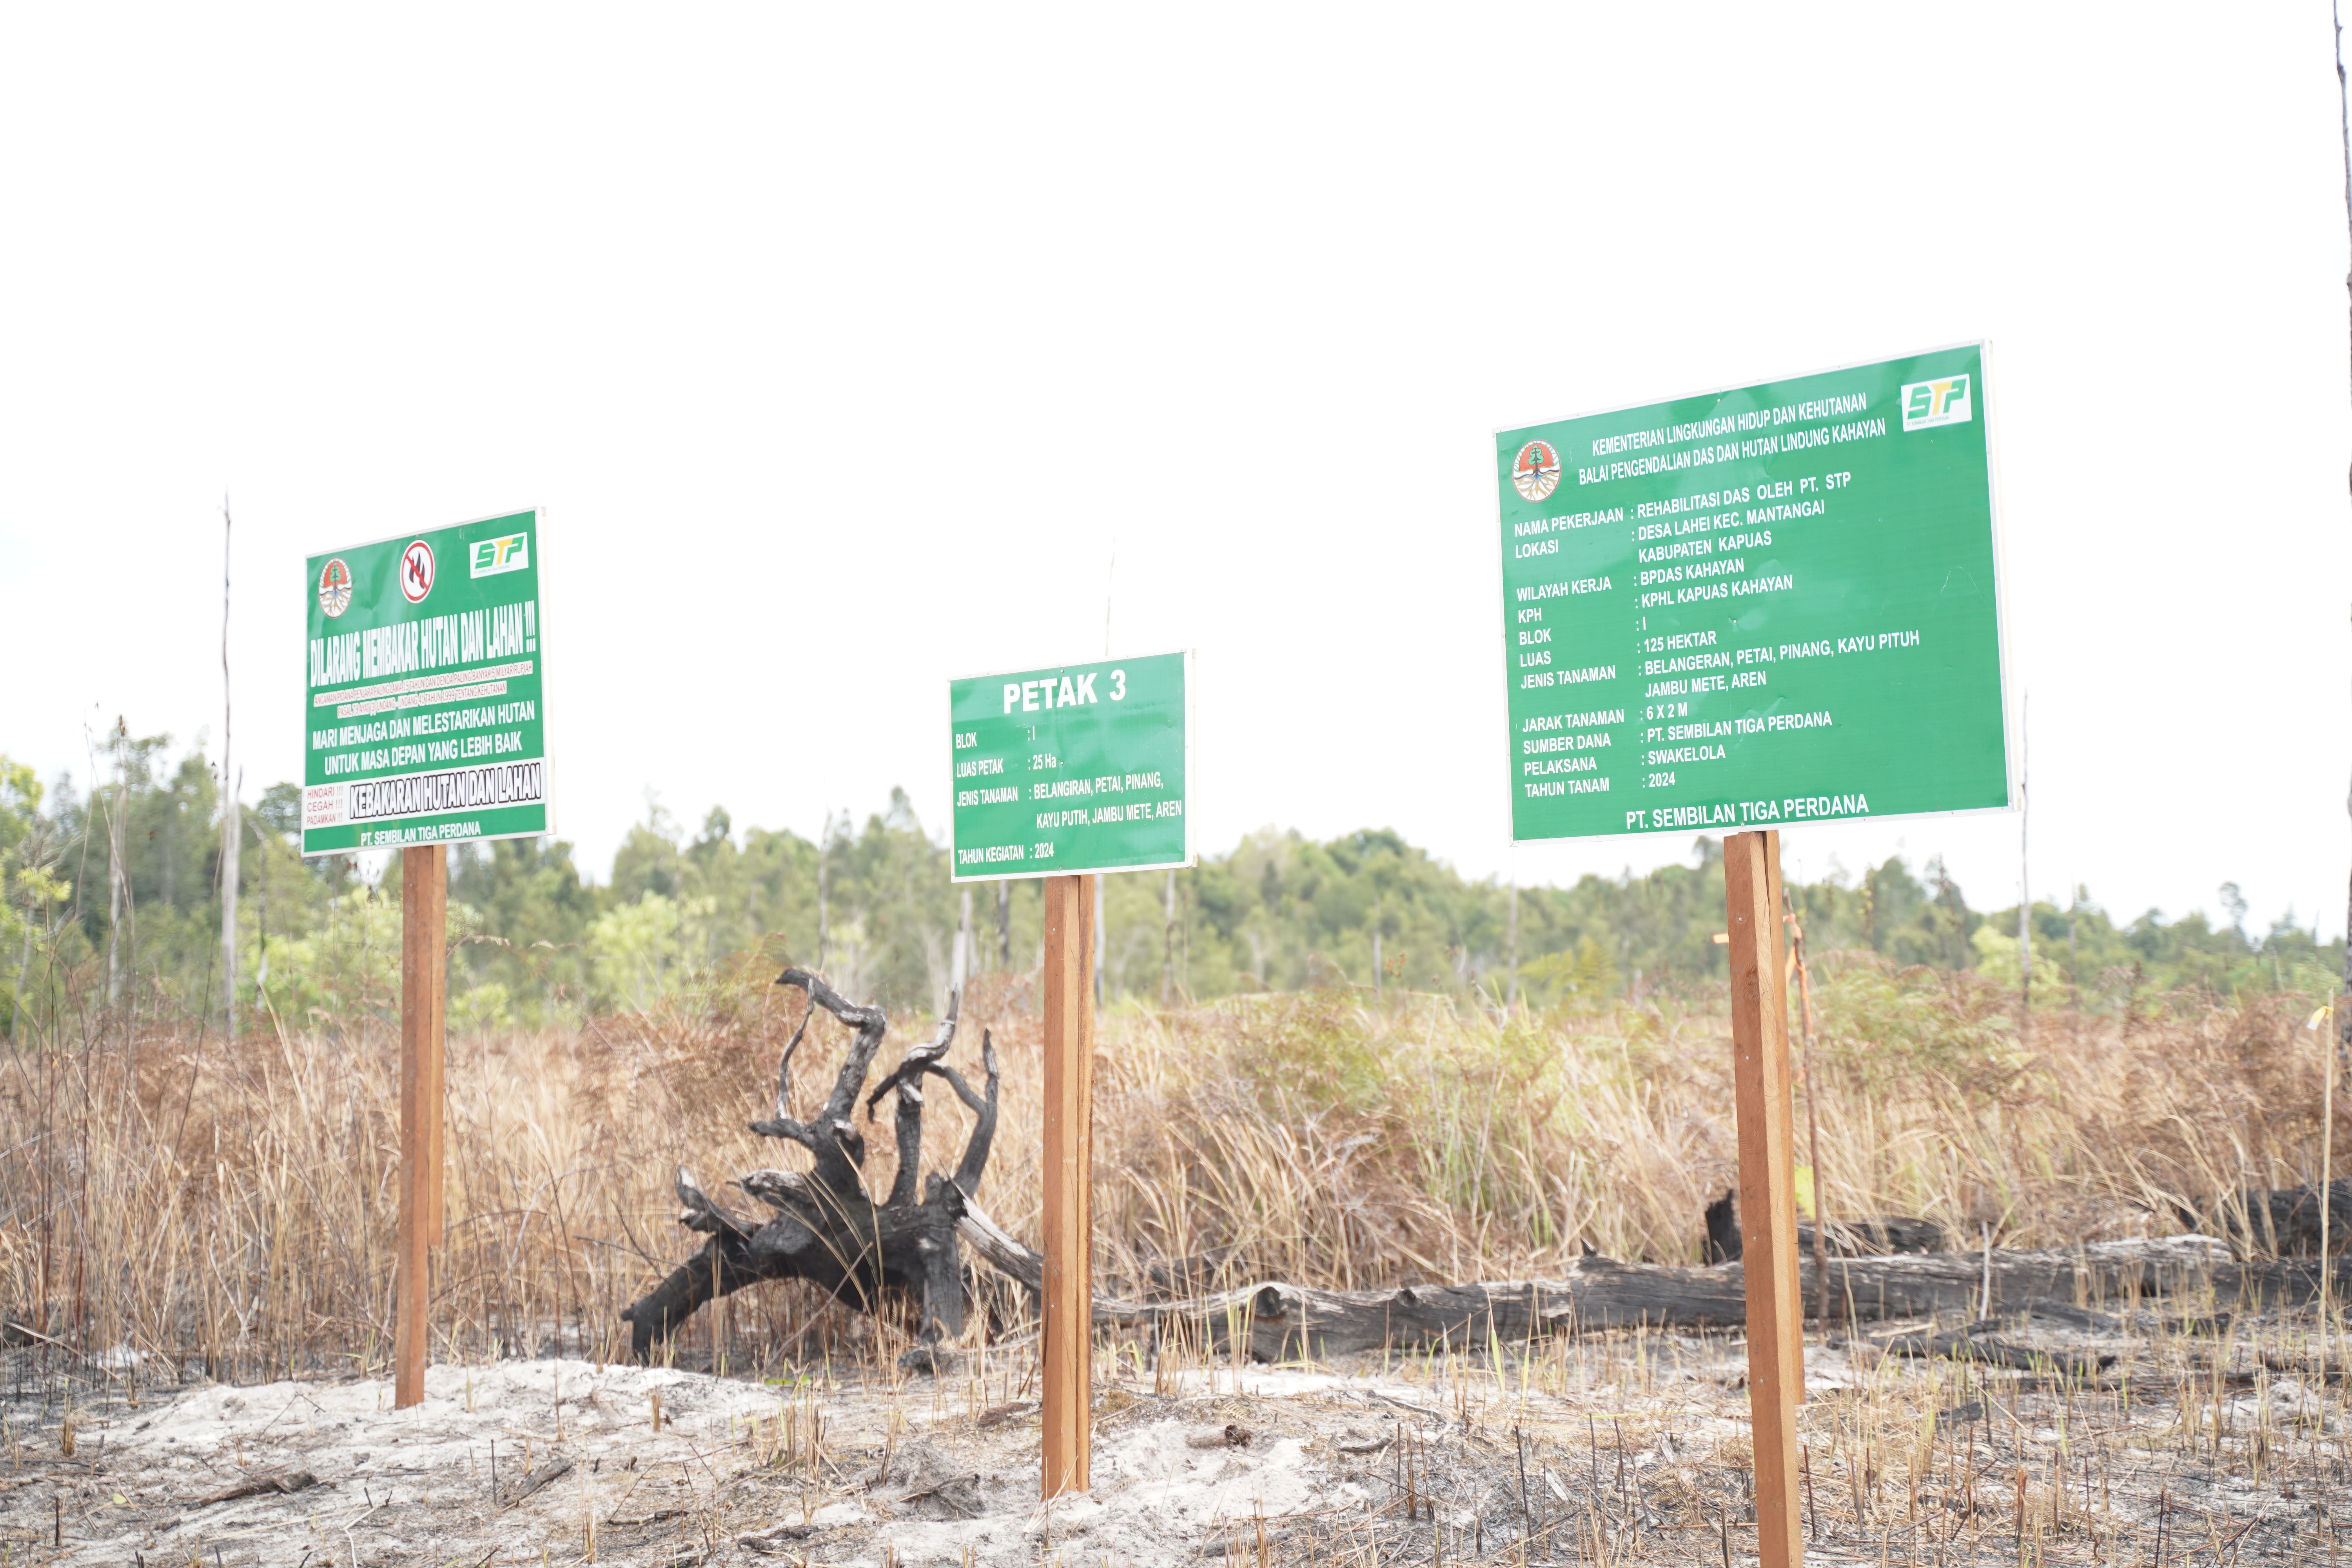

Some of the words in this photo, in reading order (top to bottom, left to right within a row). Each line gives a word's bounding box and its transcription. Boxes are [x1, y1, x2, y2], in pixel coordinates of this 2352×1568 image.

[1907, 378, 1967, 420] STP
[1592, 428, 1664, 456] KEMENTERIAN
[1667, 416, 1735, 443] LINGKUNGAN
[1738, 410, 1770, 431] HIDUP
[1773, 405, 1796, 425] DAN
[1798, 392, 1866, 421] KEHUTANAN
[1579, 465, 1609, 485] BALAI
[1611, 451, 1691, 479] PENGENDALIAN
[1693, 447, 1714, 466] DAS
[1717, 443, 1739, 462] DAN
[1742, 436, 1778, 458] HUTAN
[1781, 427, 1829, 451] LINDUNG
[1832, 418, 1886, 443] KAHAYAN
[1515, 519, 1549, 537] NAMA
[1552, 507, 1623, 531] PEKERJAAN
[1637, 492, 1720, 518] REHABILITASI
[1724, 487, 1750, 505] DAS
[1757, 481, 1793, 499] OLEH
[1800, 477, 1818, 493] PT.
[1826, 472, 1851, 489] STP
[1515, 539, 1558, 559] LOKASI
[1639, 523, 1672, 541] DESA
[1675, 516, 1710, 535] LAHEI
[1714, 512, 1743, 529] KEC.
[1747, 499, 1824, 524] MANTANGAI
[1639, 539, 1712, 563] KABUPATEN
[1719, 530, 1772, 551] KAPUAS
[475, 535, 524, 570] STP
[1517, 582, 1568, 601] WILAYAH
[1572, 576, 1612, 594] KERJA
[1641, 566, 1682, 585] BPDAS
[1686, 558, 1744, 579] KAHAYAN
[1518, 608, 1542, 623] KPH
[1642, 591, 1675, 608] KPHL
[1678, 583, 1728, 603] KAPUAS
[1732, 574, 1793, 596] KAHAYAN
[310, 632, 360, 687] DILARANG
[363, 621, 419, 679] MEMBAKAR
[421, 614, 458, 669] HUTAN
[461, 610, 483, 663] DAN
[486, 603, 523, 659] LAHAN
[1519, 628, 1552, 645] BLOK
[1520, 651, 1551, 667] LUAS
[1644, 637, 1664, 652] 125
[1667, 631, 1717, 650] HEKTAR
[1521, 672, 1554, 689] JENIS
[1557, 665, 1616, 684] TANAMAN
[1645, 652, 1733, 675] BELANGERAN,
[1737, 647, 1776, 664] PETAI,
[1780, 640, 1834, 659] PINANG,
[1838, 635, 1874, 653] KAYU
[1879, 630, 1919, 649] PITUH
[1004, 673, 1098, 714] PETAK
[1109, 669, 1126, 701] 3
[1645, 679, 1688, 697] JAMBU
[1691, 675, 1728, 693] METE,
[1731, 671, 1766, 688] AREN
[313, 729, 337, 749] MARI
[339, 722, 388, 746] MENJAGA
[390, 718, 410, 739] DAN
[413, 706, 495, 735] MELESTARIKAN
[498, 700, 534, 724] HUTAN
[1523, 715, 1563, 732] JARAK
[1565, 709, 1624, 728] TANAMAN
[1647, 706, 1653, 720] 6
[1657, 704, 1664, 719] X
[1668, 704, 1675, 718] 2
[1678, 702, 1688, 717] M
[1524, 736, 1574, 754] SUMBER
[1577, 733, 1611, 749] DANA
[1648, 727, 1664, 742] PT.
[1668, 720, 1731, 740] SEMBILAN
[1735, 717, 1765, 734] TIGA
[1768, 711, 1833, 731] PERDANA
[325, 753, 359, 775] UNTUK
[361, 749, 390, 770] MASA
[392, 744, 425, 766] DEPAN
[428, 739, 457, 761] YANG
[461, 735, 492, 758] LEBIH
[495, 731, 522, 753] BAIK
[956, 732, 977, 749] BLOK
[956, 761, 976, 778] LUAS
[978, 758, 1004, 775] PETAK
[1033, 754, 1043, 769] 25
[1045, 753, 1056, 768] Ha
[1524, 757, 1597, 776] PELAKSANA
[1648, 744, 1726, 765] SWAKELOLA
[307, 786, 334, 799] HINDARI
[350, 777, 421, 819] KEBAKARAN
[423, 771, 466, 811] HUTAN
[468, 768, 495, 806] DAN
[497, 762, 541, 803] LAHAN
[957, 790, 978, 807] JENIS
[980, 786, 1018, 804] TANAMAN
[1034, 779, 1093, 799] BELANGIRAN,
[1095, 776, 1123, 793] PETAI,
[1125, 771, 1163, 790] PINANG,
[1525, 781, 1564, 797] TAHUN
[1568, 777, 1609, 794] TANAM
[1649, 771, 1675, 787] 2024
[307, 800, 333, 812] CEGAH
[307, 813, 336, 825] PADAMKAN
[1036, 812, 1059, 828] KAYU
[1062, 809, 1090, 826] PUTIH,
[1092, 806, 1123, 823] JAMBU
[1126, 803, 1154, 820] METE,
[1156, 800, 1181, 817] AREN
[1626, 810, 1648, 829] PT.
[1653, 804, 1735, 828] SEMBILAN
[1740, 800, 1780, 821] TIGA
[1784, 794, 1869, 818] PERDANA
[361, 832, 372, 846] PT.
[374, 828, 416, 845] SEMBILAN
[418, 826, 437, 840] TIGA
[439, 821, 481, 838] PERDANA
[958, 848, 984, 864] TAHUN
[986, 845, 1024, 862] KEGIATAN
[1034, 842, 1054, 858] 2024
